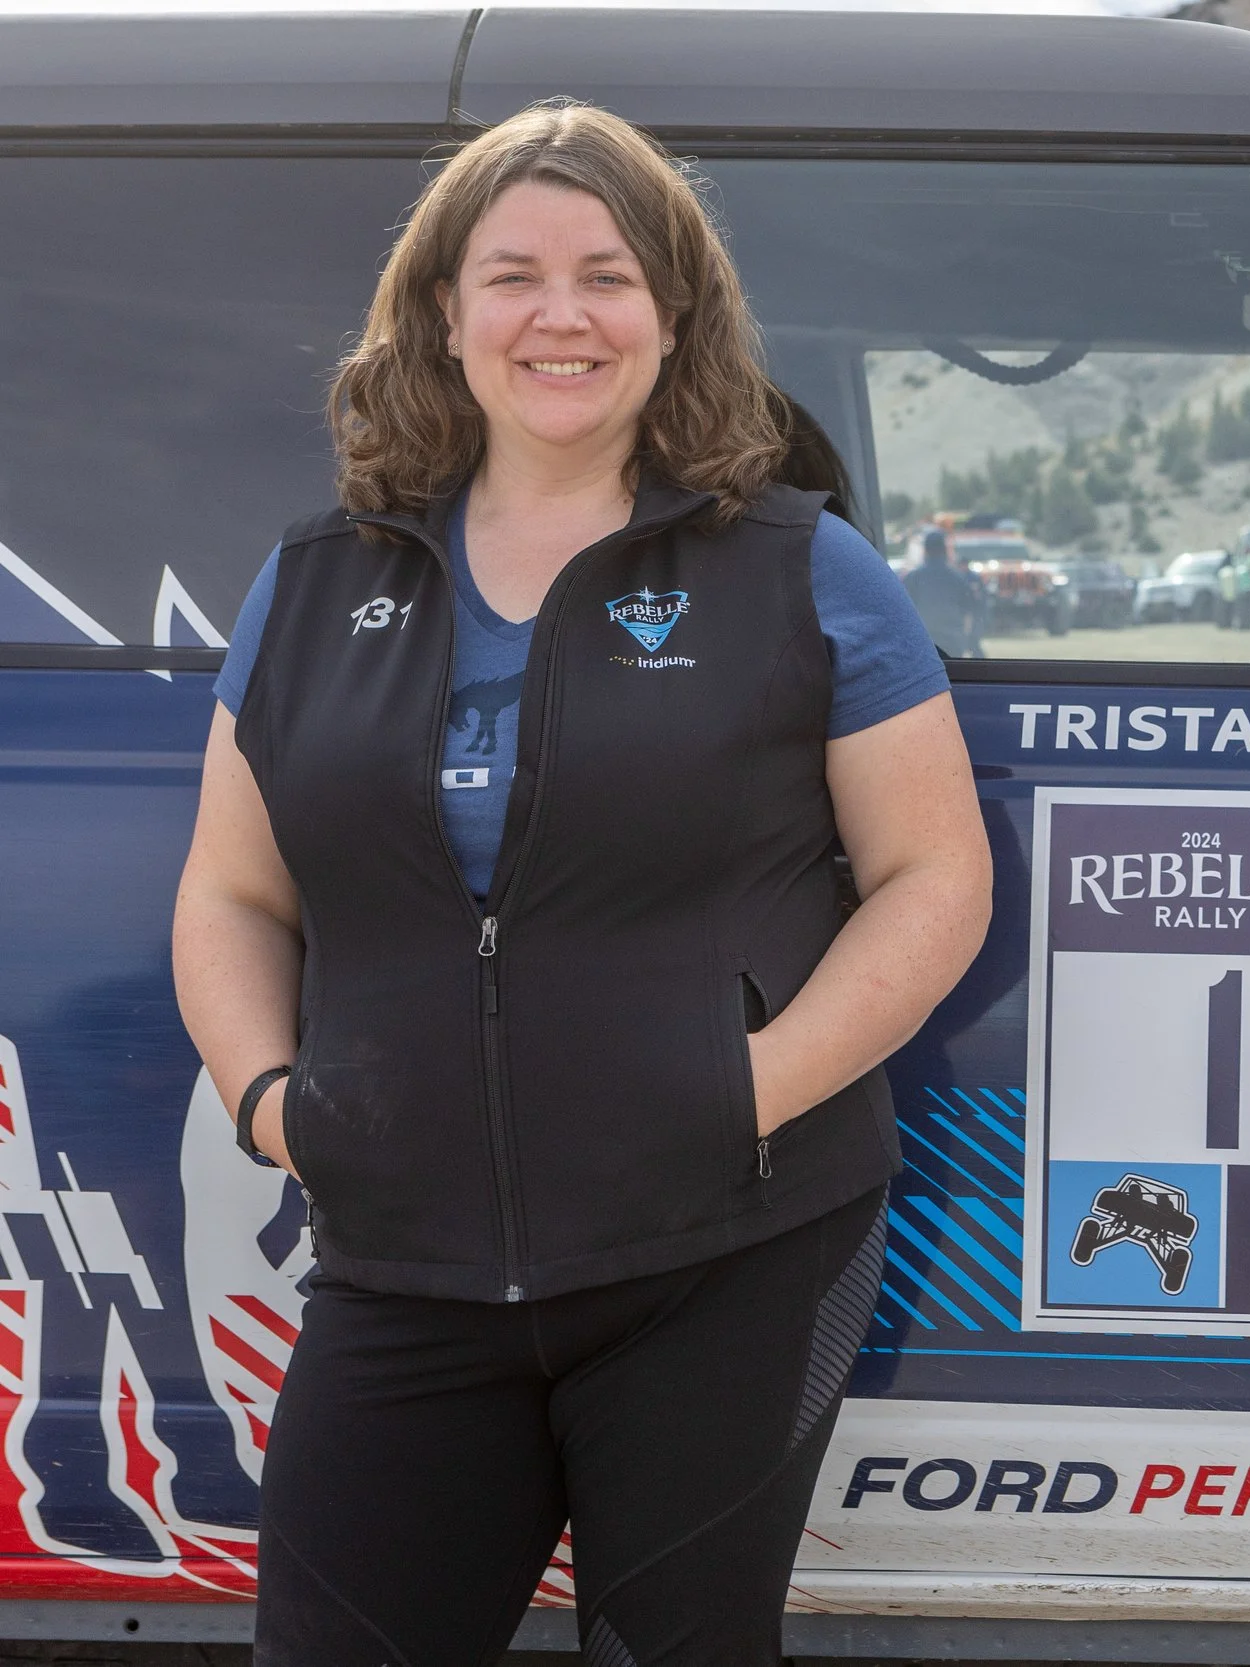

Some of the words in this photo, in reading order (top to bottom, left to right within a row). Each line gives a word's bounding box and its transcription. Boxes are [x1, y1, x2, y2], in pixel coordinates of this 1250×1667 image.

[350, 596, 413, 636] 131
[609, 601, 690, 622] REBELLE
[635, 614, 664, 624] RALLY
[642, 636, 658, 644] '24
[637, 656, 695, 669] iridium
[1181, 832, 1222, 849] 2024
[1155, 906, 1247, 929] RALLY
[1130, 1224, 1152, 1239] TC
[841, 1456, 1119, 1514] FORD
